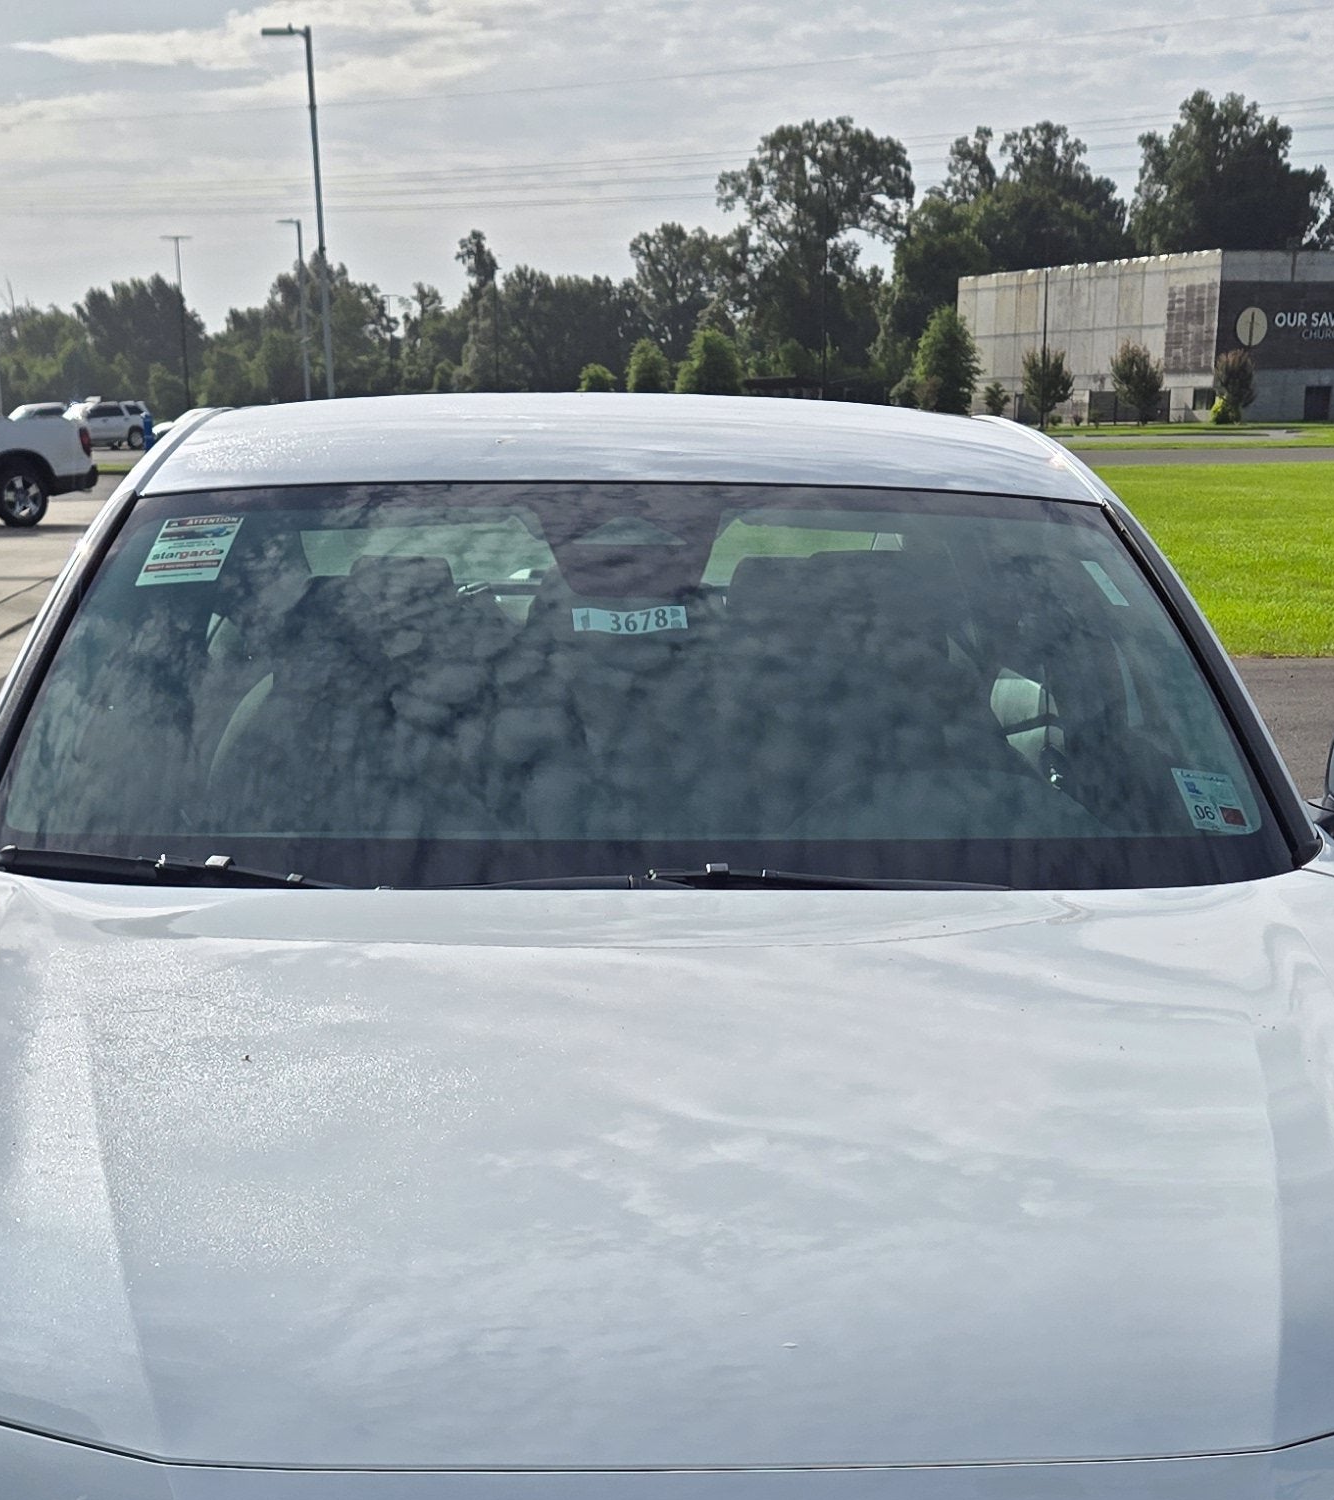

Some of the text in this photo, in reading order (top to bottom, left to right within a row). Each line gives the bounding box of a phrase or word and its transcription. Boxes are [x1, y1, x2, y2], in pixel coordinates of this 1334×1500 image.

[1275, 312, 1307, 327] OUR
[186, 516, 238, 525] ATTENTION
[609, 608, 668, 632] 3678
[1194, 804, 1215, 820] 06
